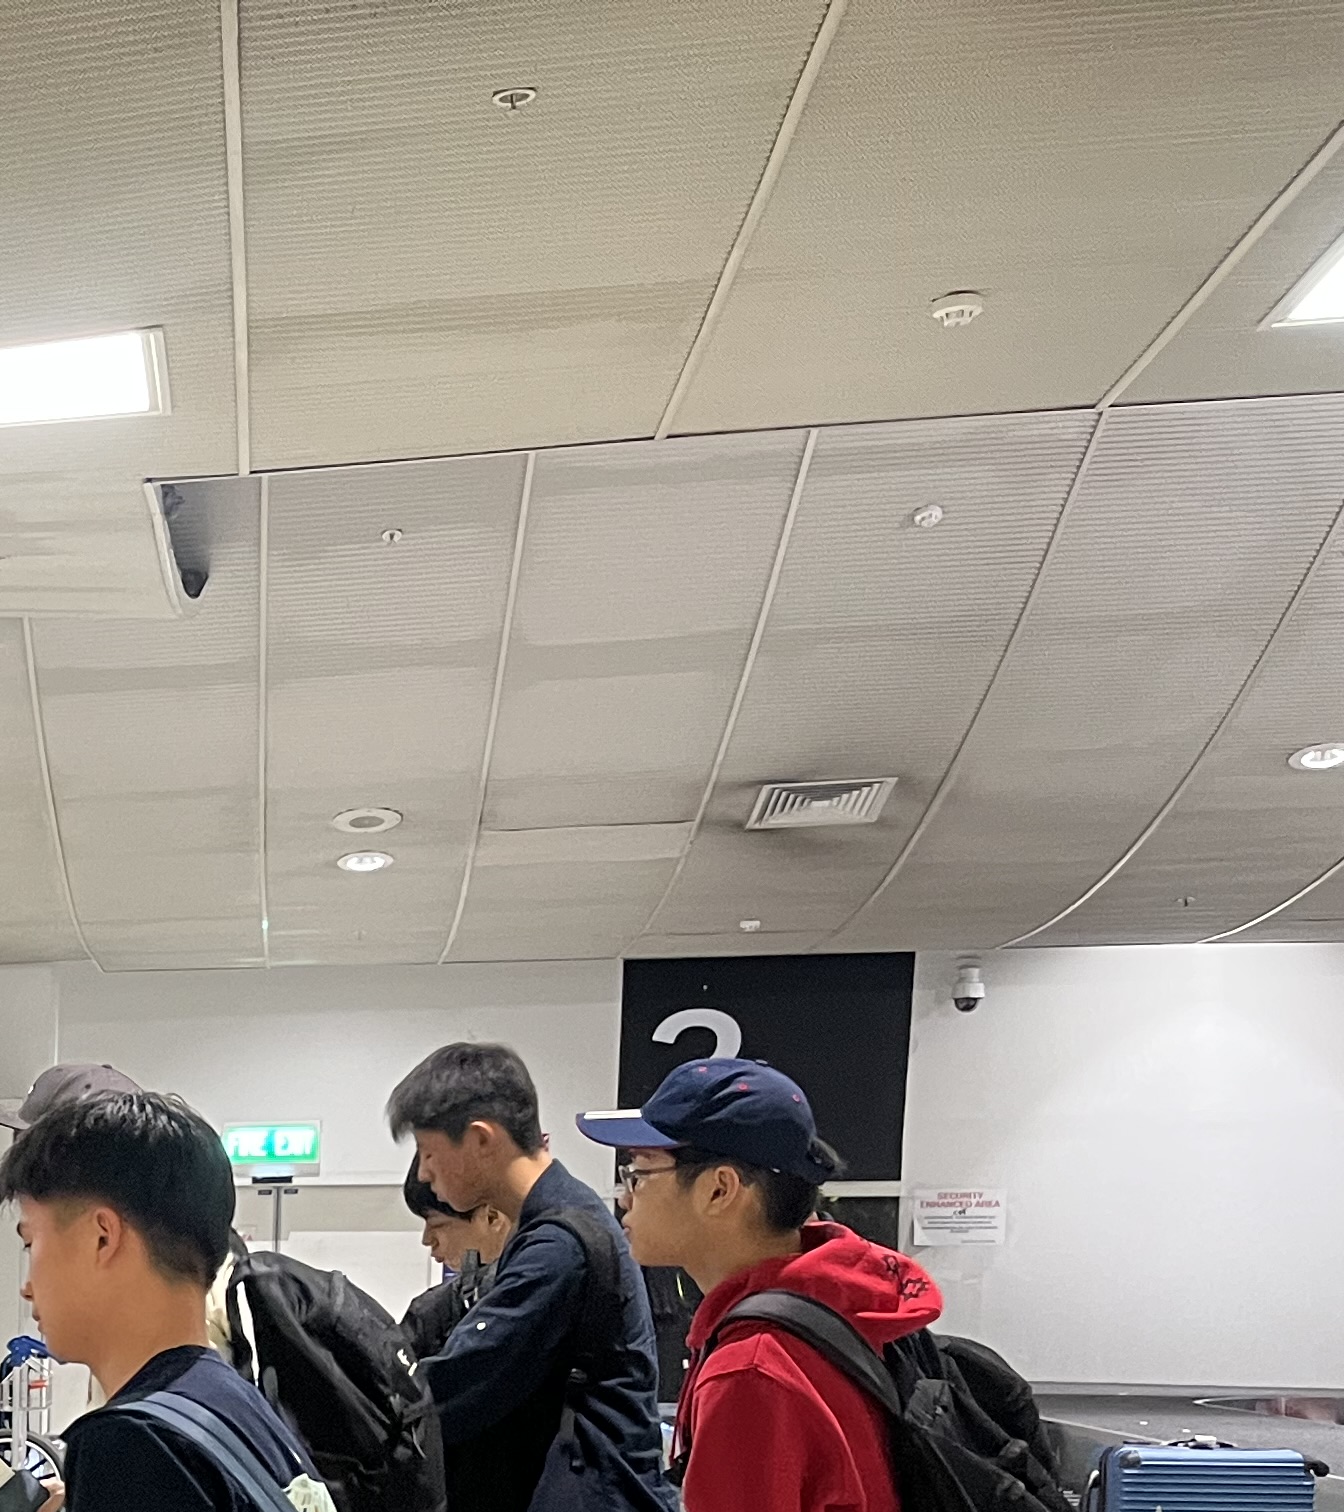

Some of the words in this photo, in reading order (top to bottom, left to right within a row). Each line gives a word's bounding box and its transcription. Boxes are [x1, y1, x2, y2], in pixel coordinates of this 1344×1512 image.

[937, 1192, 983, 1200] SECURITY
[920, 1200, 972, 1208] ENHANCED
[974, 1200, 1000, 1208] AREA
